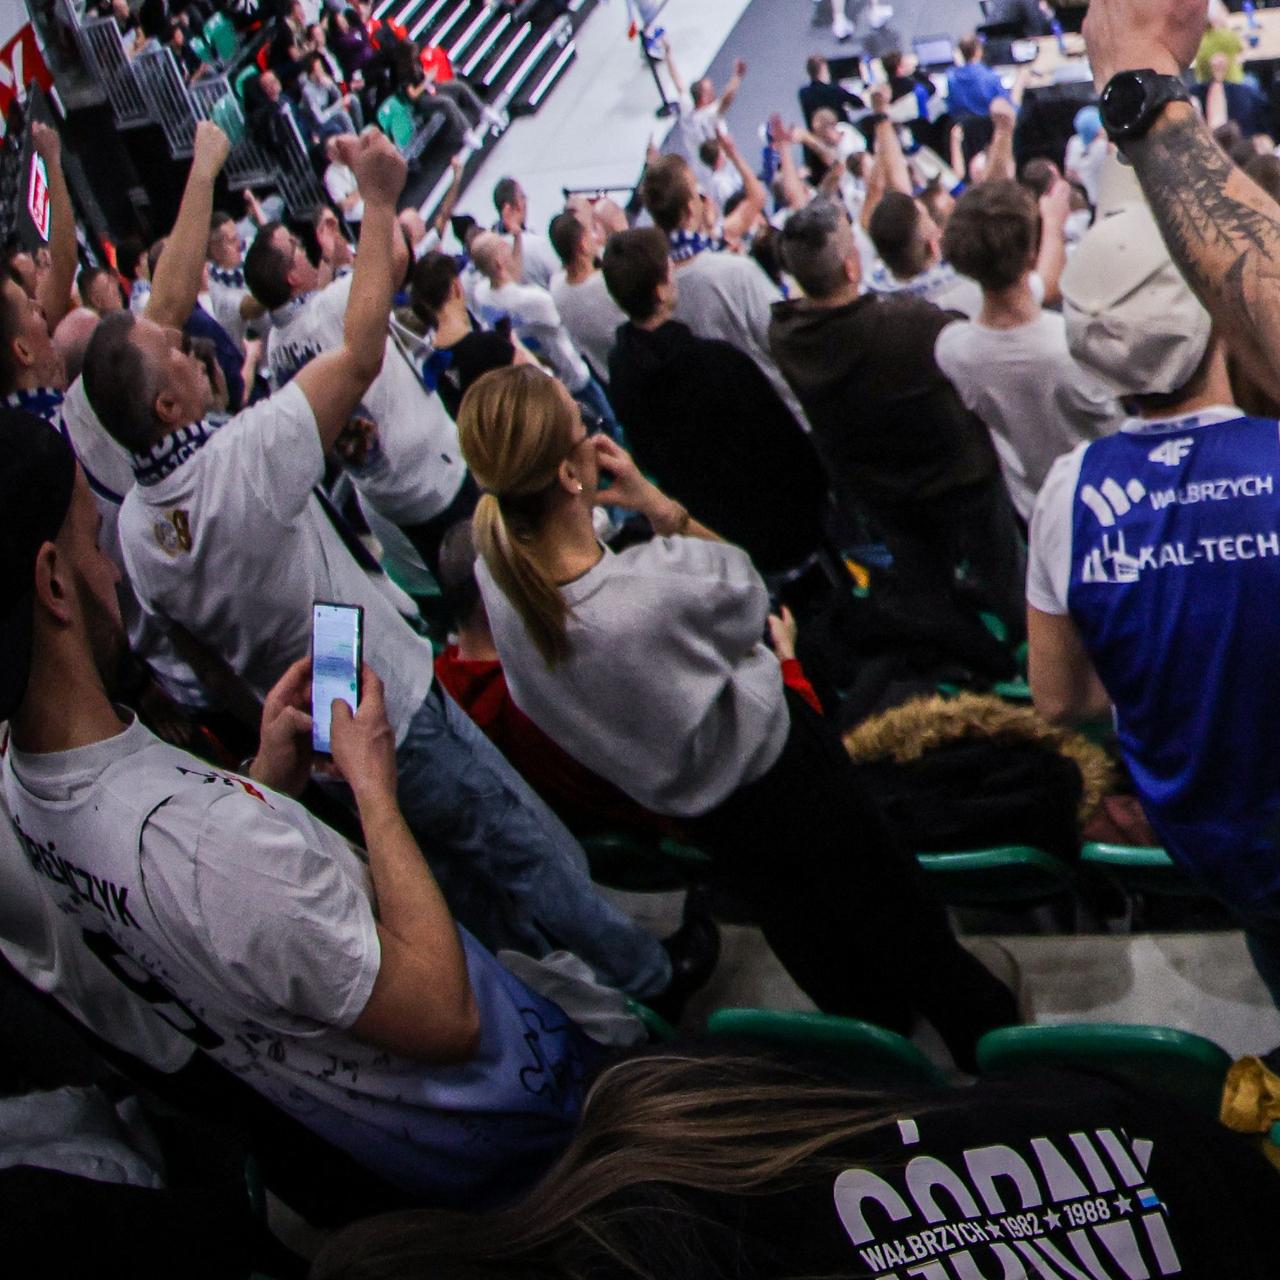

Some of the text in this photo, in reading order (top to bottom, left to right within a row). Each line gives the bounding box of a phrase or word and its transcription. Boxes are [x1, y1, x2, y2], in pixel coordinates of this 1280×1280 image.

[1148, 437, 1194, 466] 4F
[1139, 531, 1280, 570] KAL-TECH
[859, 1198, 1110, 1272] WAŁBRZYCH 1982 1988
